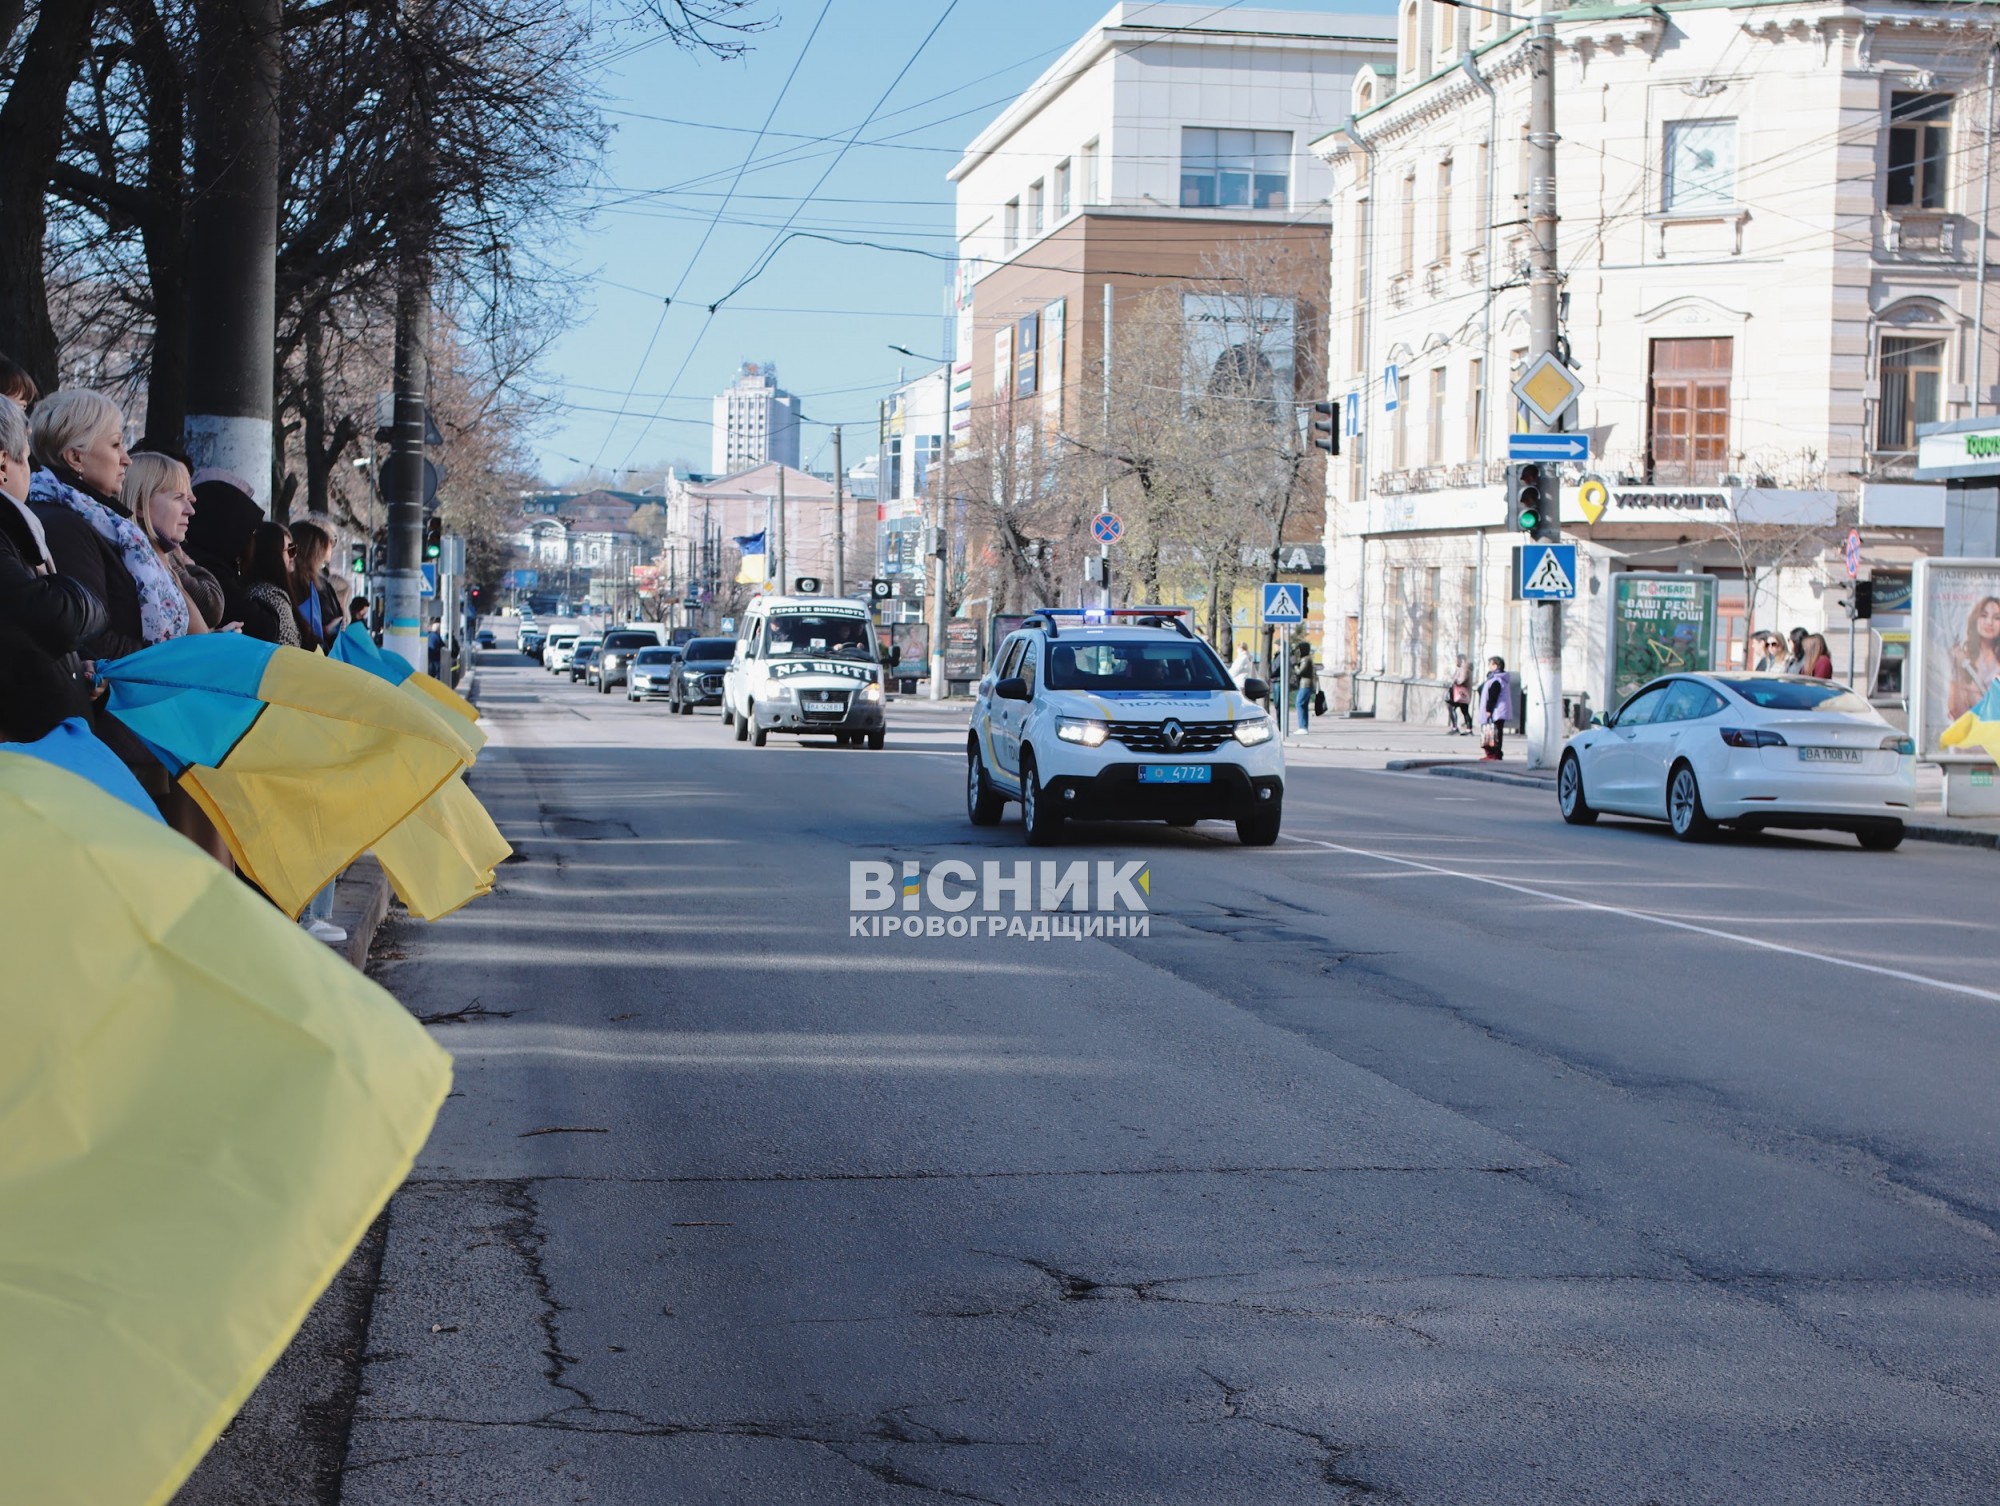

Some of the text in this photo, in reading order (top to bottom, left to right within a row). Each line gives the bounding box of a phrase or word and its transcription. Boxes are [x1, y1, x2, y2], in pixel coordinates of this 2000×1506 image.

[1613, 493, 1729, 510] УКРПОШТА
[1640, 582, 1693, 595] ЛОМБАРД
[1626, 599, 1660, 609] ВАШІ
[771, 607, 798, 615] ГЕРОЇ
[1624, 609, 1704, 621] ВАШІ ГРОШІ
[812, 663, 872, 681] ЩИТІ
[1806, 748, 1820, 759] BA
[1172, 766, 1204, 779] 4772
